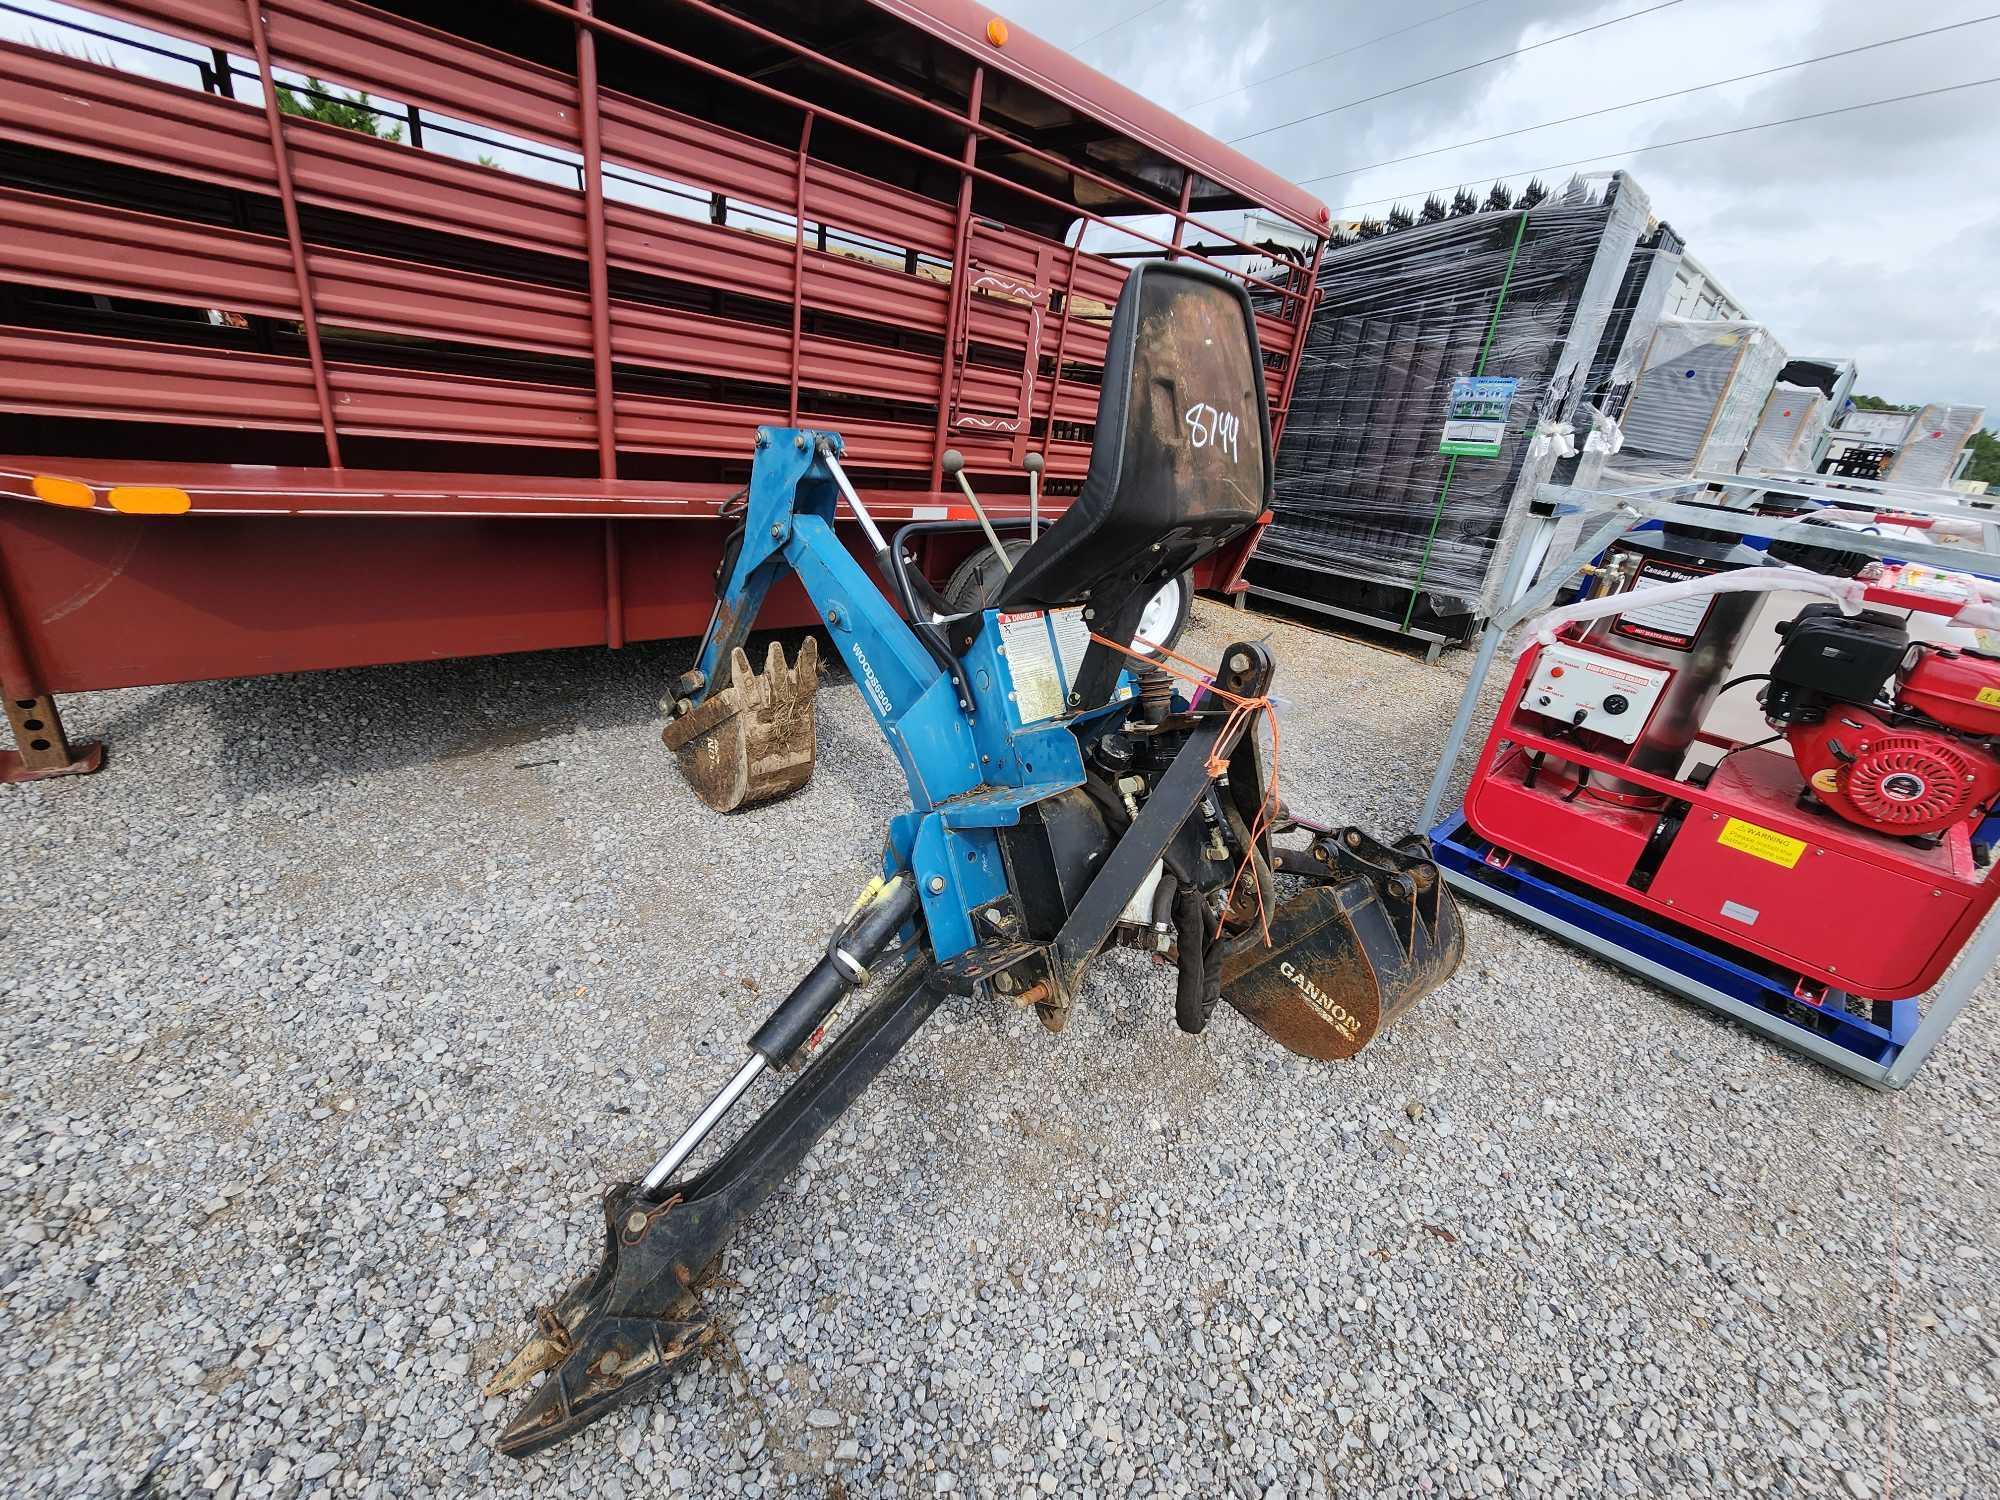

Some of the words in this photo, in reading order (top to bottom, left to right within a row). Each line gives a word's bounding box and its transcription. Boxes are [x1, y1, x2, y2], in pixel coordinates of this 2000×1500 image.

[1186, 403, 1239, 464] 8744
[1644, 565, 1671, 577] Canada
[1012, 611, 1038, 622] DANGER
[1747, 828, 1793, 847] WARNING
[1280, 962, 1361, 1032] GANNON
